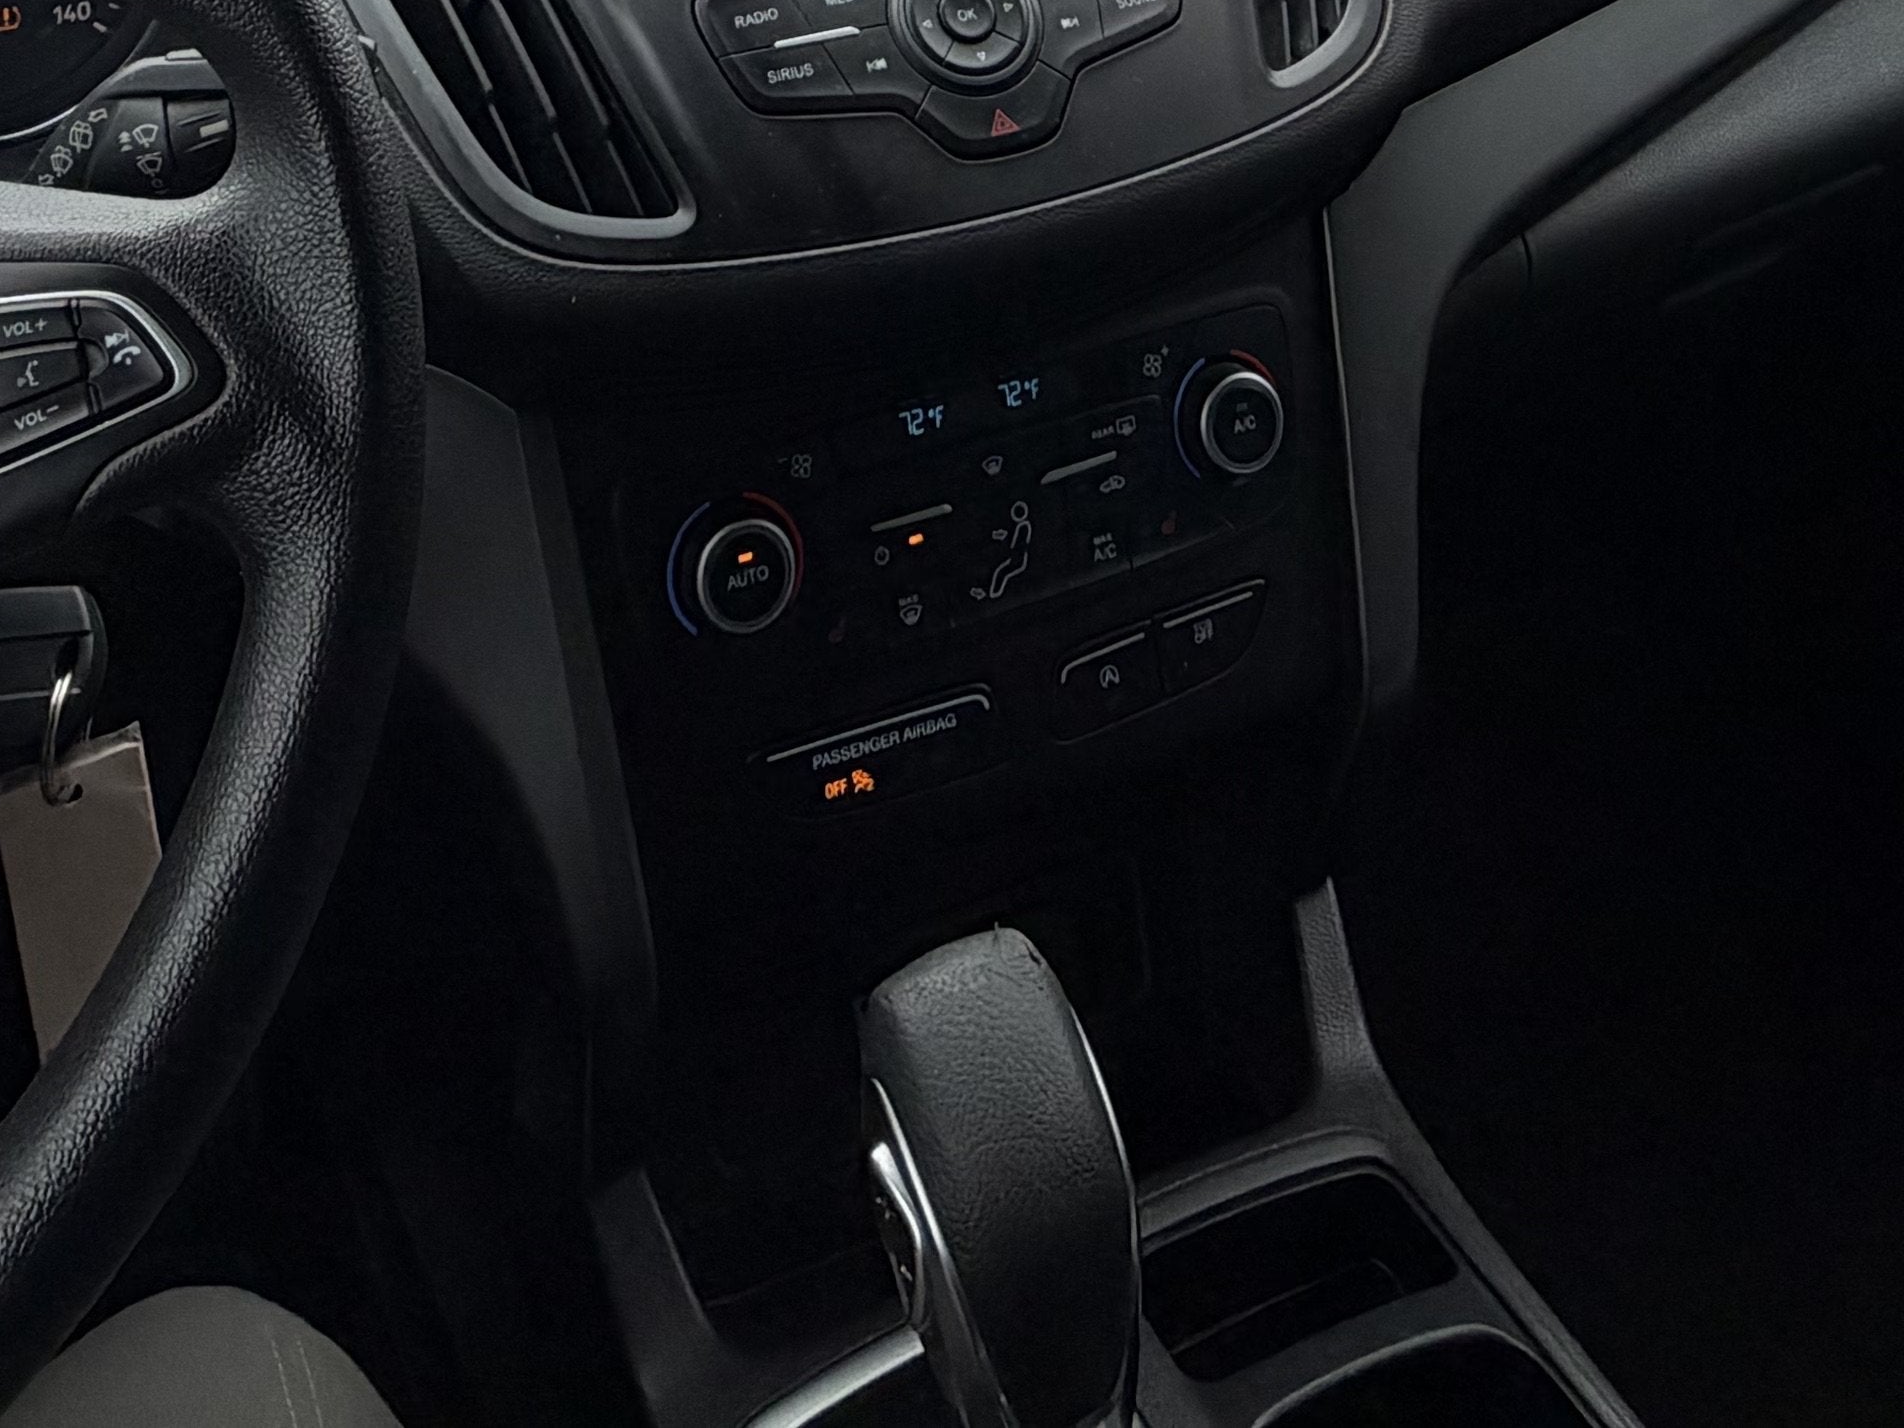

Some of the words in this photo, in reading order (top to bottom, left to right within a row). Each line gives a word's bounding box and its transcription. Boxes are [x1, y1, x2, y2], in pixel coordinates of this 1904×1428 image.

[52, 0, 92, 25] 140
[733, 7, 779, 30] RADIO
[957, 8, 977, 23] OK
[767, 63, 815, 85] SIRIUS
[1233, 414, 1257, 434] A/C
[726, 564, 769, 591] AUTO
[812, 730, 900, 770] PASSENGER
[902, 712, 958, 742] AIRBAG
[824, 777, 848, 800] OFF
